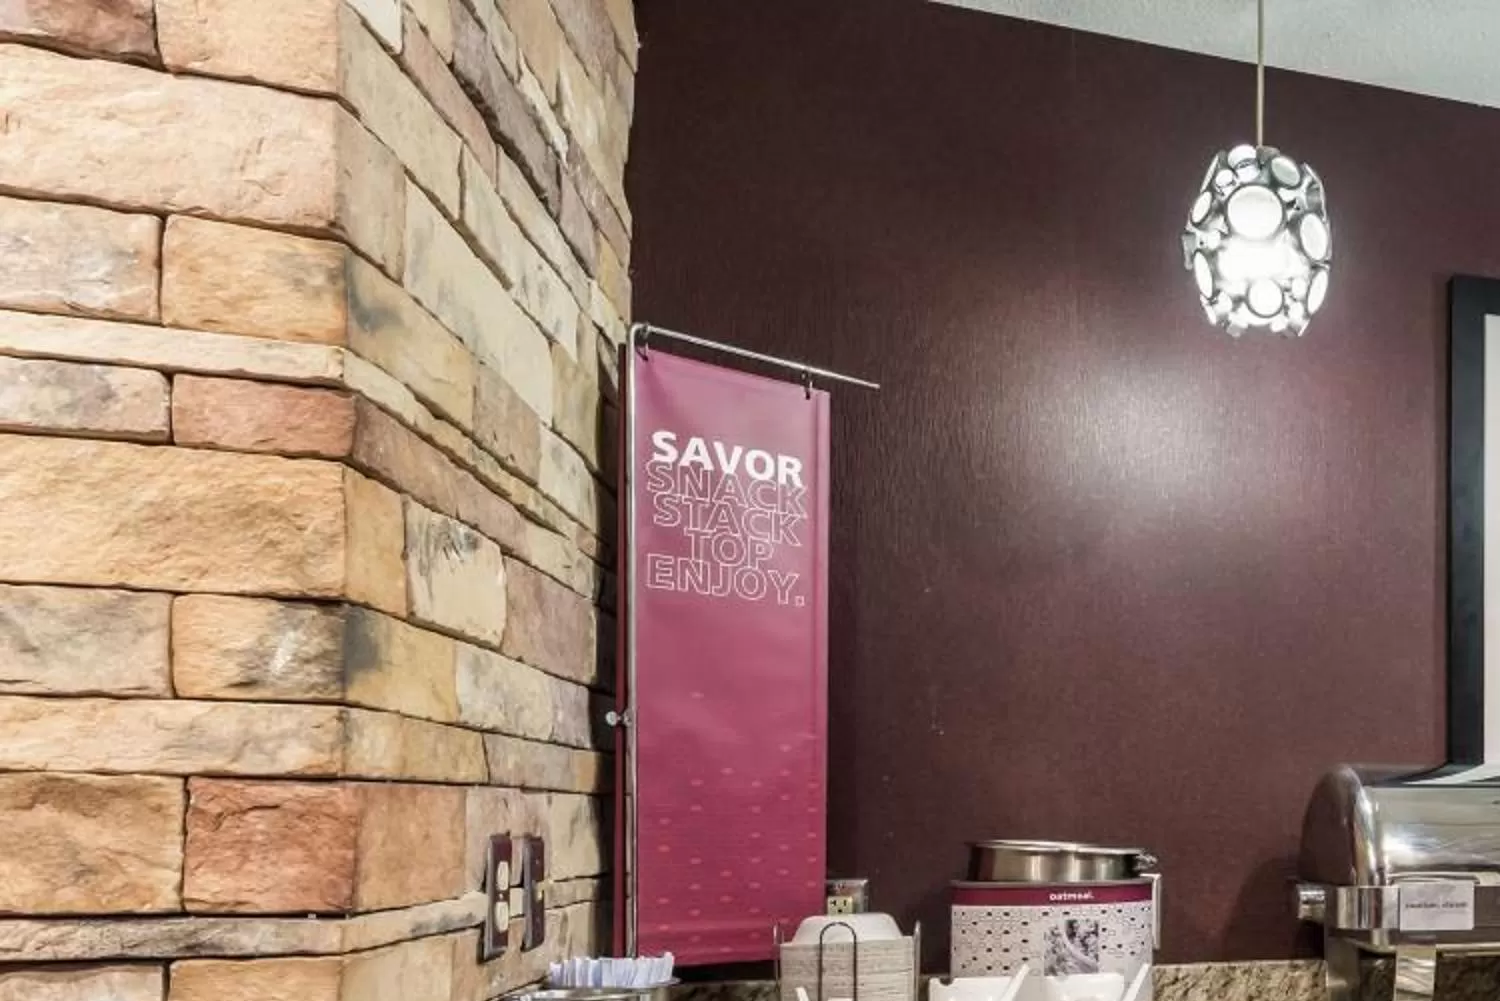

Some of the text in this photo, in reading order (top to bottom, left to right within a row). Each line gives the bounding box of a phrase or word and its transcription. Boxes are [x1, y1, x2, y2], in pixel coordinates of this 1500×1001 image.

[652, 430, 803, 487] SAVOR
[646, 459, 807, 518] SNACK
[653, 491, 803, 546] STACK
[684, 526, 775, 570] TOP
[647, 552, 805, 606] ENJOY.
